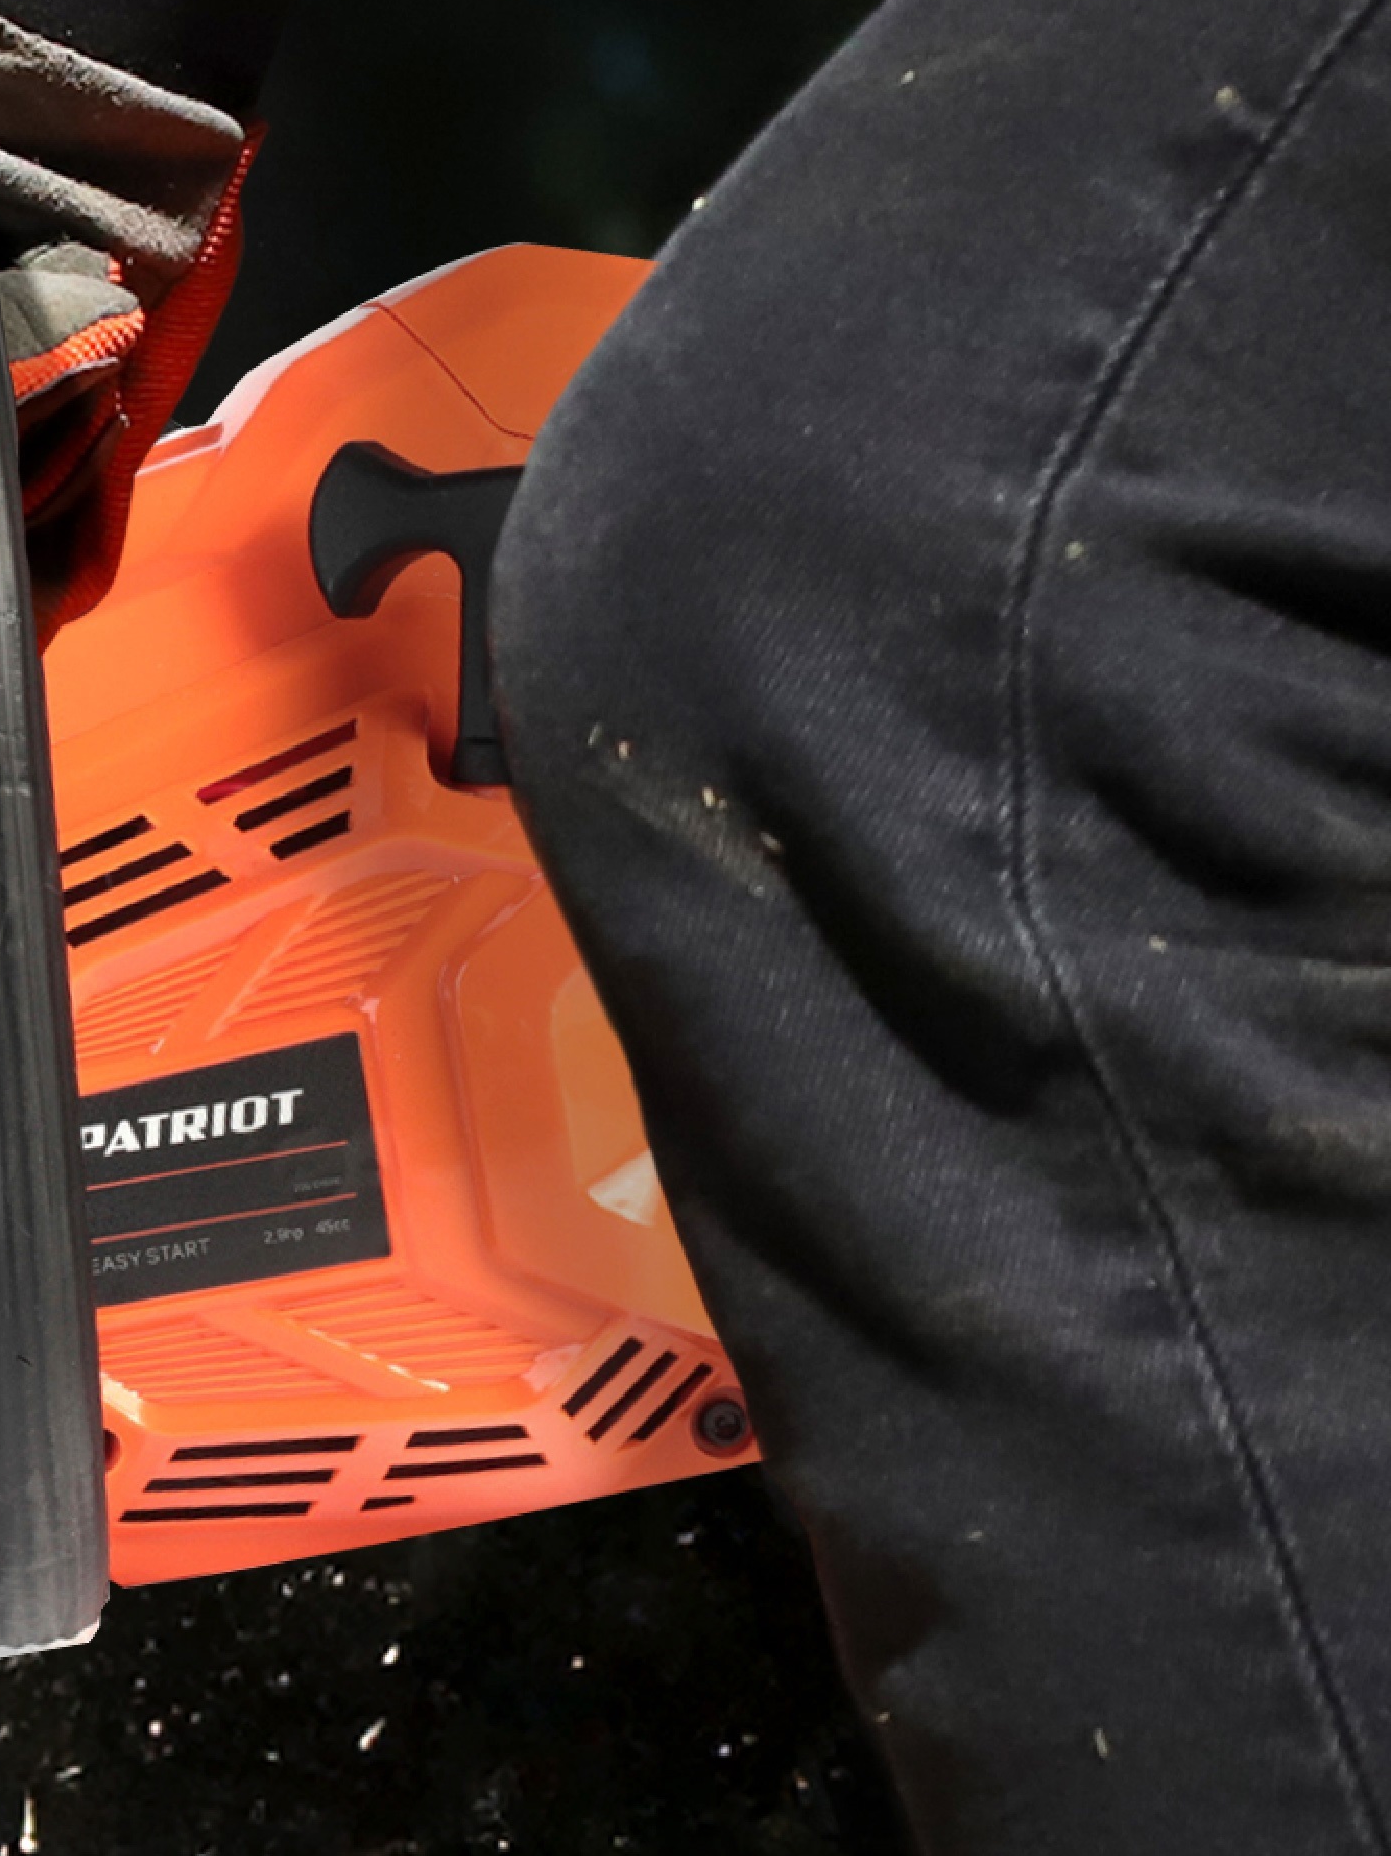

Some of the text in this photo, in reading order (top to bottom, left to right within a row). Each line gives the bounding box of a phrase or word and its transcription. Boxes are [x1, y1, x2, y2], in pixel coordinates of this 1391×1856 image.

[80, 1088, 304, 1157] PATRIOT
[91, 1237, 212, 1277] EASY START
